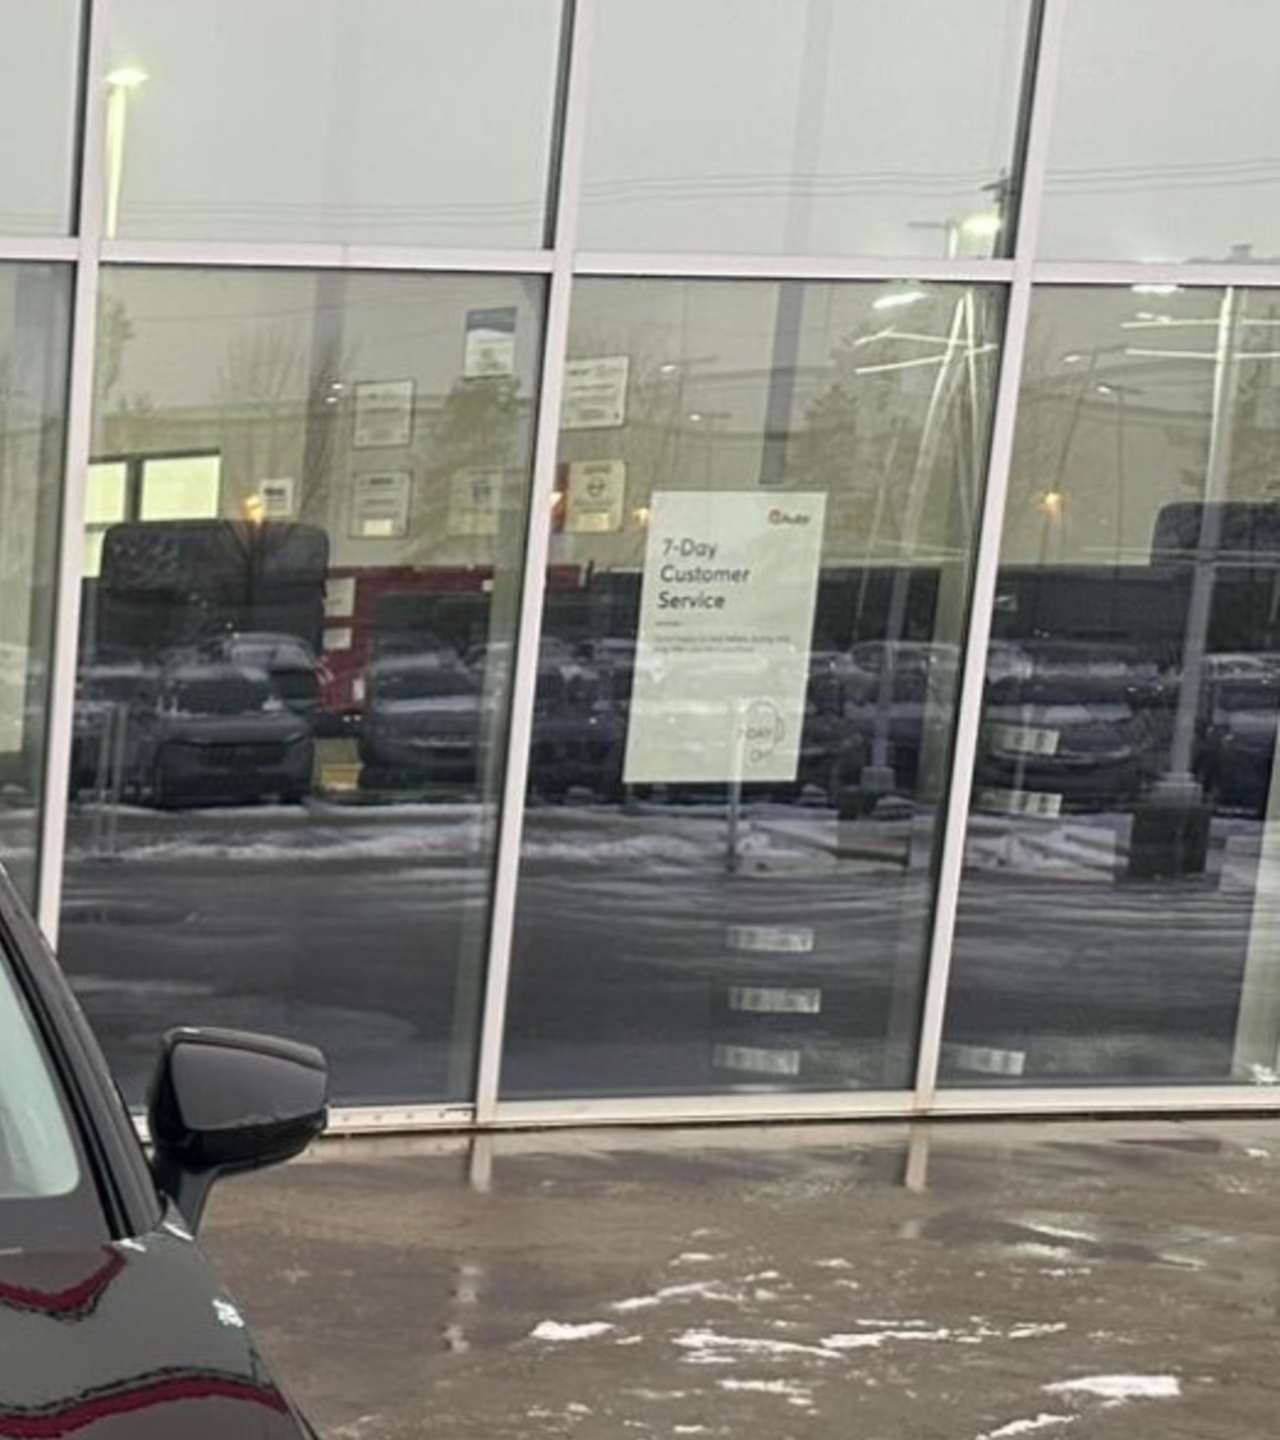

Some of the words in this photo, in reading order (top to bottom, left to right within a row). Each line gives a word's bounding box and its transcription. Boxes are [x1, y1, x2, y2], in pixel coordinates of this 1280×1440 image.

[663, 538, 717, 558] 7-Day
[660, 564, 750, 583] Customer
[657, 591, 726, 609] Service
